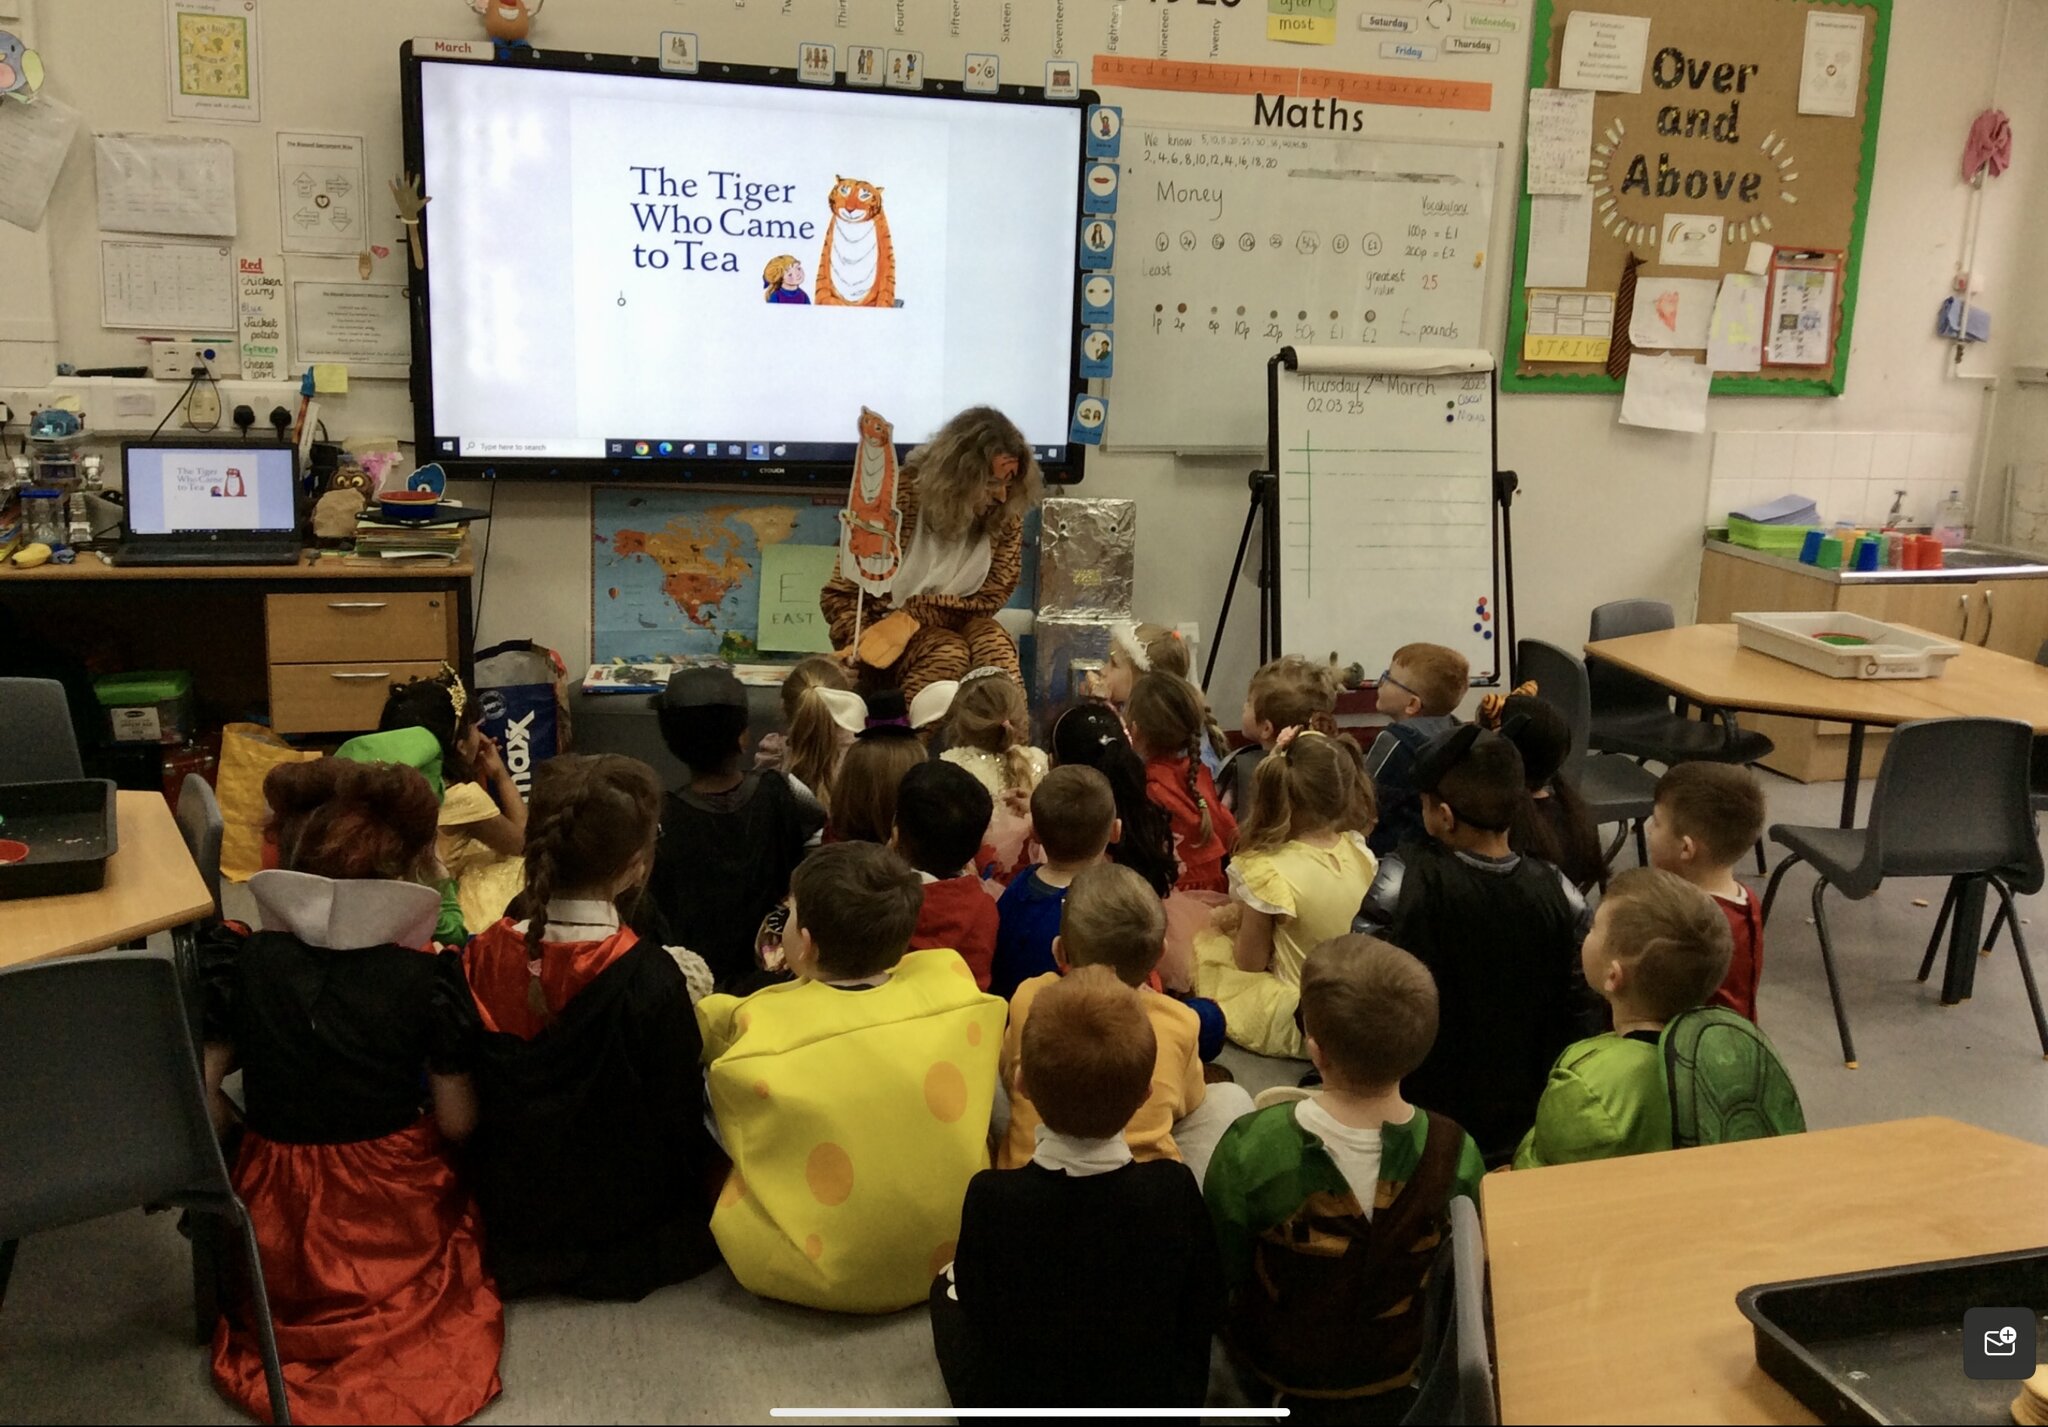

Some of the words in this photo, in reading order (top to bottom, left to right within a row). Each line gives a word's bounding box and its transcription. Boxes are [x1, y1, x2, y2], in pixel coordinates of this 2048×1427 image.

[1001, 3, 1012, 42] Sixteen
[1054, 0, 1064, 55] Seventeen
[1109, 4, 1120, 51] Eighteen
[1160, 8, 1169, 57] Nineteen
[1279, 18, 1315, 31] most
[1368, 17, 1409, 30] Saturday
[1470, 17, 1517, 30] Wednesday
[435, 41, 472, 53] March
[1210, 18, 1222, 58] Twenty
[1453, 39, 1492, 52] Thursday
[1395, 46, 1423, 58] Friday
[1652, 47, 1759, 94] Over
[1254, 93, 1363, 132] Maths
[1656, 99, 1740, 144] and
[1144, 132, 1158, 147] We
[1168, 135, 1192, 147] know
[1620, 152, 1761, 203] Above
[629, 166, 698, 198] The
[708, 170, 796, 211] Tiger
[1157, 180, 1223, 221] Money
[630, 203, 712, 234] Who
[719, 208, 815, 239] Came
[1408, 224, 1427, 239] 100p
[1445, 225, 1459, 239] £1
[633, 243, 669, 269] to
[674, 239, 739, 272] Tea
[1405, 245, 1427, 260] 200p
[1442, 246, 1455, 259] £2
[240, 258, 263, 270] Red
[1365, 269, 1406, 290] greatest
[1422, 274, 1439, 290] 25
[244, 288, 275, 300] curry
[244, 316, 278, 328] Jacket
[1234, 320, 1250, 340] 10p
[1263, 324, 1283, 344] 20p
[1419, 321, 1459, 344] pounds
[243, 343, 278, 355] Green
[1530, 339, 1609, 358] STRIVE
[1301, 374, 1359, 401] Thursday
[1387, 376, 1437, 397] March
[1307, 398, 1323, 413] 02
[1326, 398, 1343, 413] 03
[481, 442, 497, 451] Type
[498, 443, 514, 451] here
[177, 467, 193, 475] The
[197, 467, 218, 477] Tiger
[779, 572, 813, 603] E
[772, 612, 816, 625] EAST
